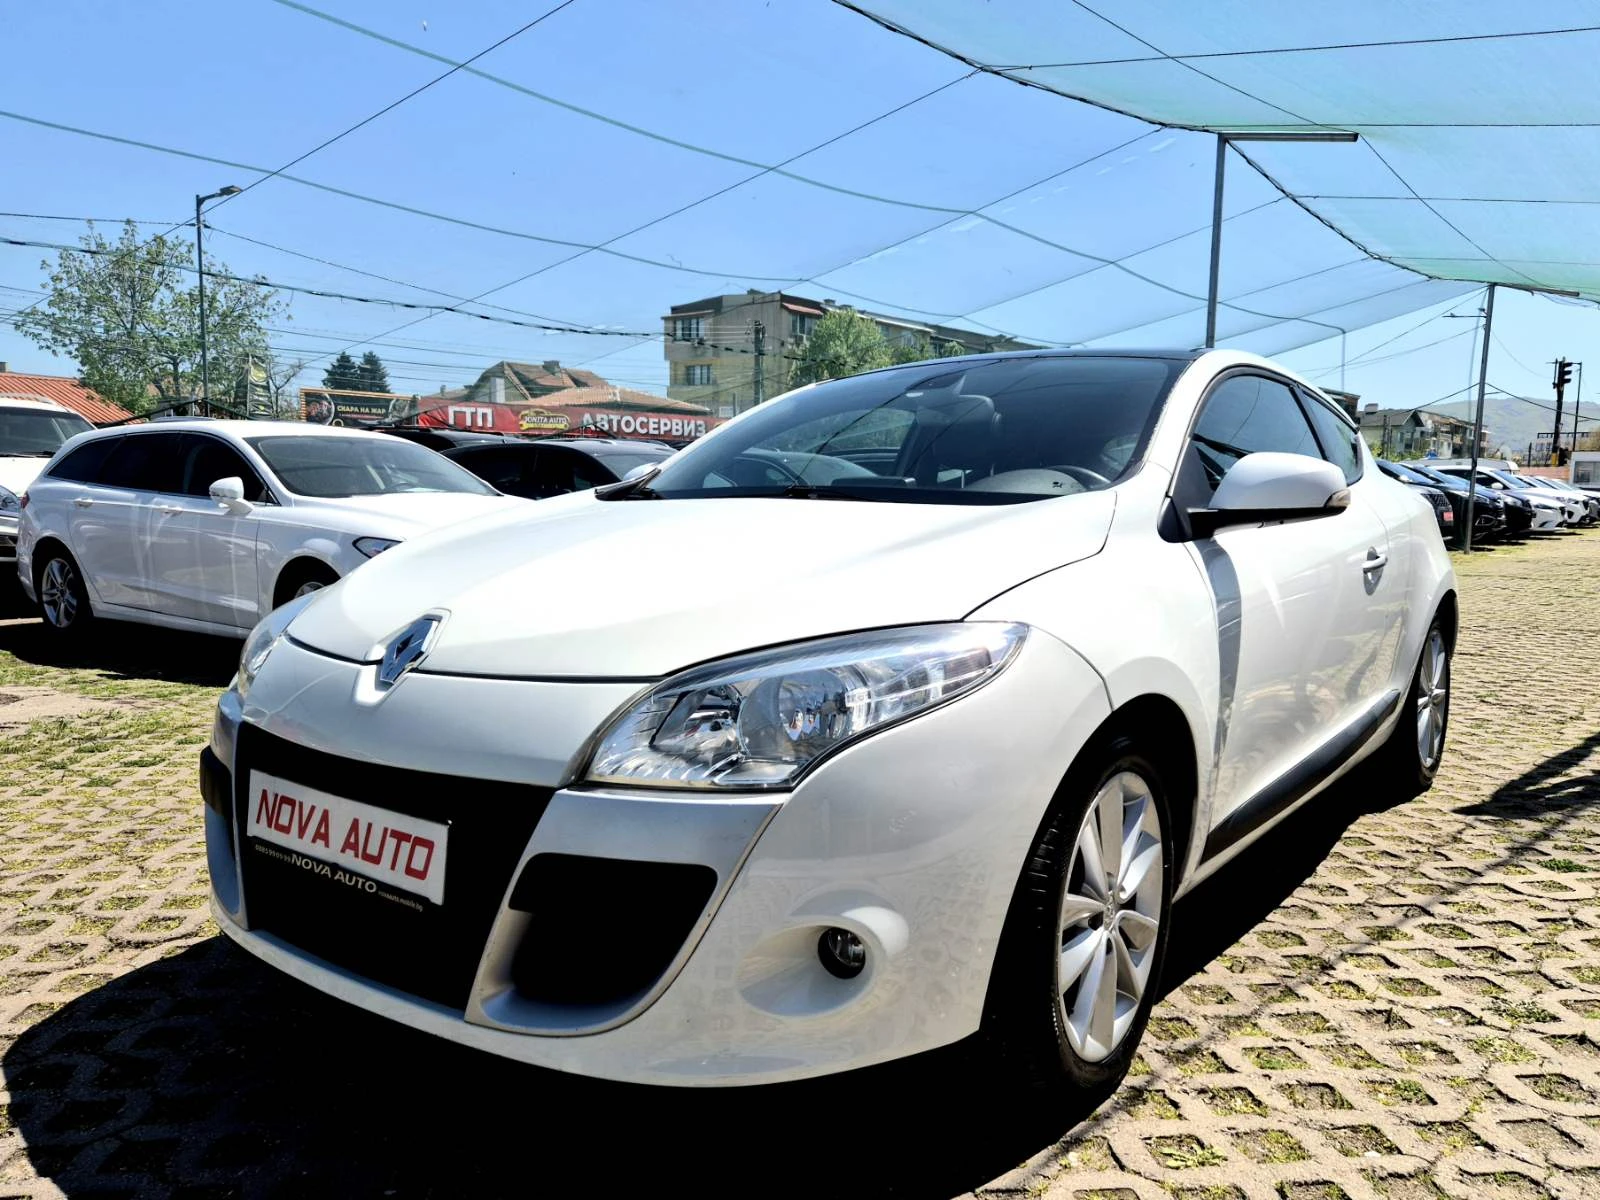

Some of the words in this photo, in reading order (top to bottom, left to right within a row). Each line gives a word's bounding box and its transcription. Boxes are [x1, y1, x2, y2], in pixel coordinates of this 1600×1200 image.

[448, 406, 493, 427] ГТП
[582, 413, 706, 437] АВТОСЕРВИЗ
[255, 788, 330, 848] NOVA
[340, 818, 435, 881] AUTO
[291, 854, 331, 879] NOVA
[334, 870, 377, 893] AUTO
